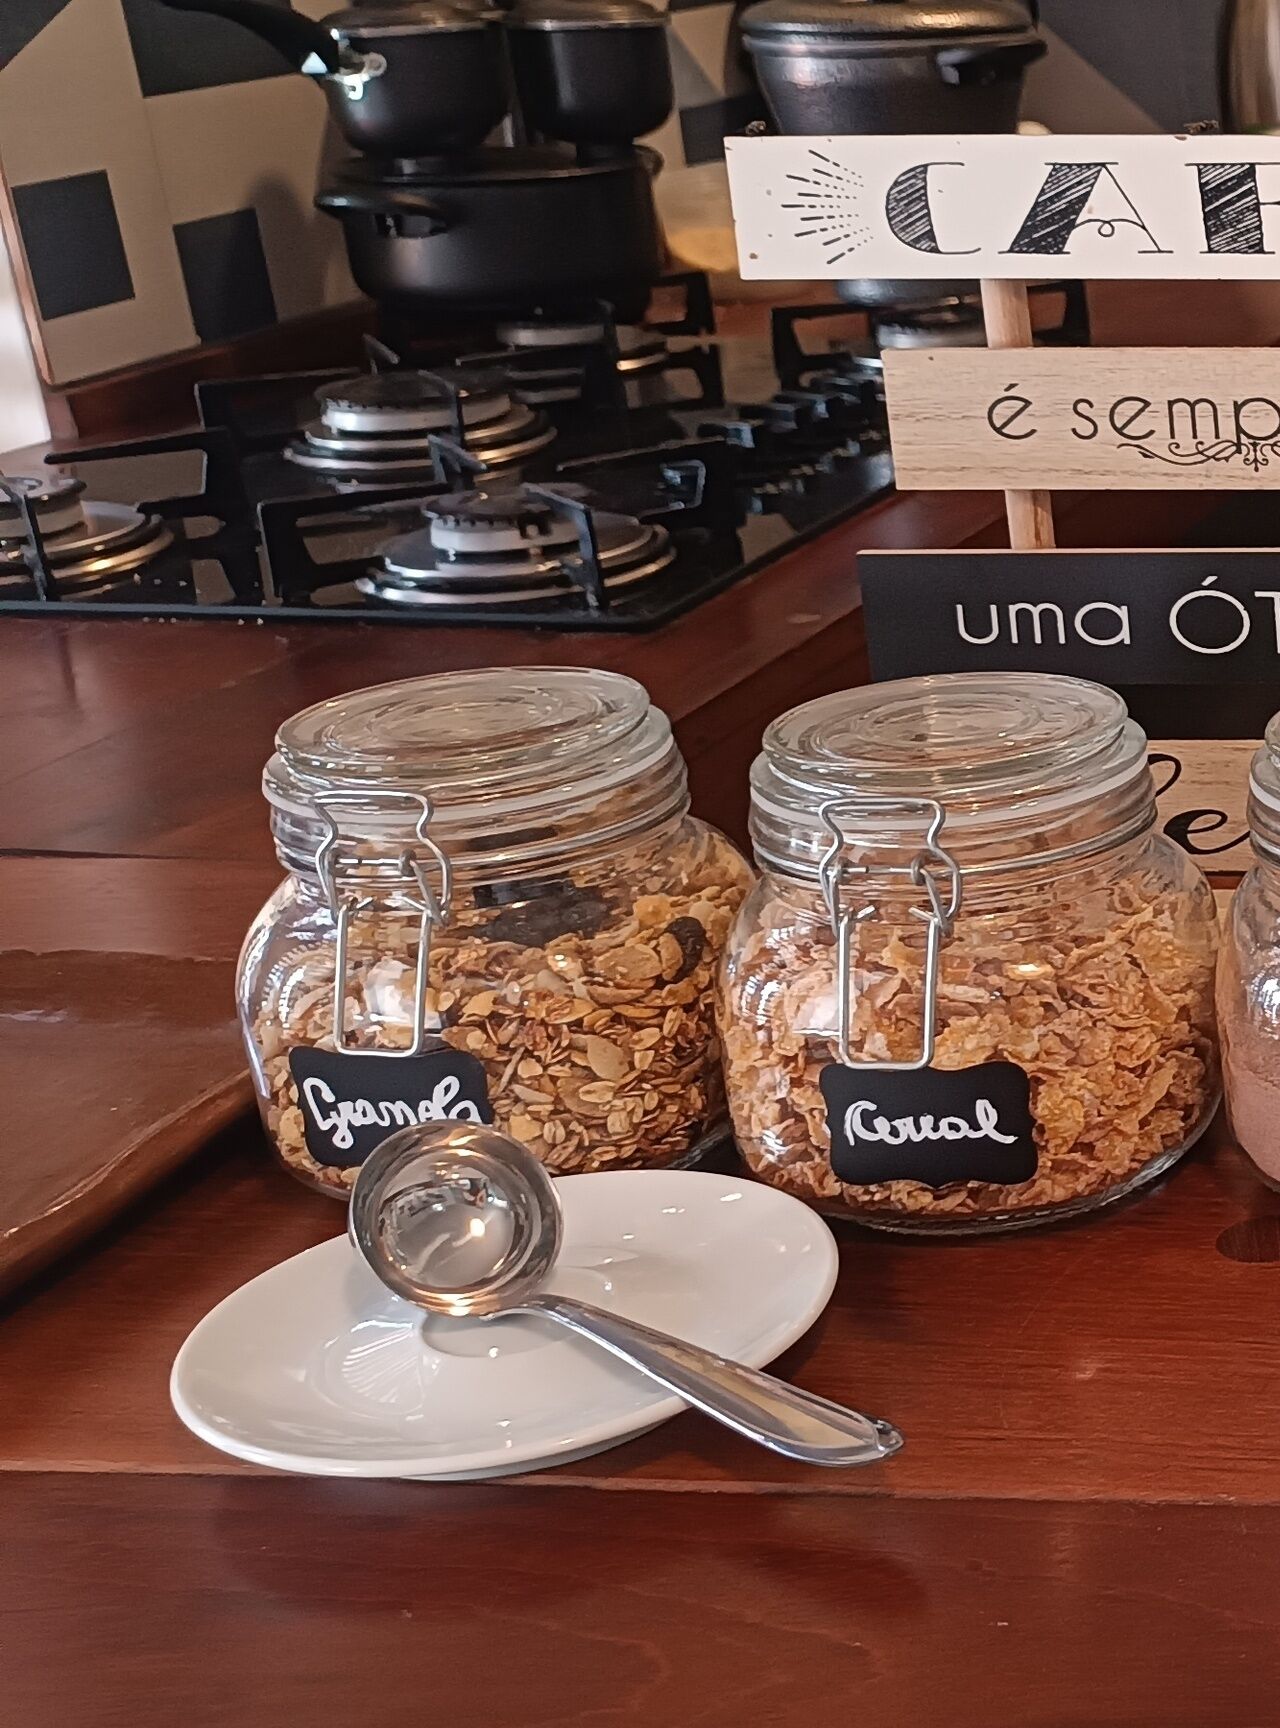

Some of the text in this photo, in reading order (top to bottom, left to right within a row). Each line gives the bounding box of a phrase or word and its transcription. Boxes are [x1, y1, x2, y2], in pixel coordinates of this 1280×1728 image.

[987, 383, 1038, 440] é
[955, 601, 1131, 646] uma
[844, 1099, 1019, 1146] Cereal
